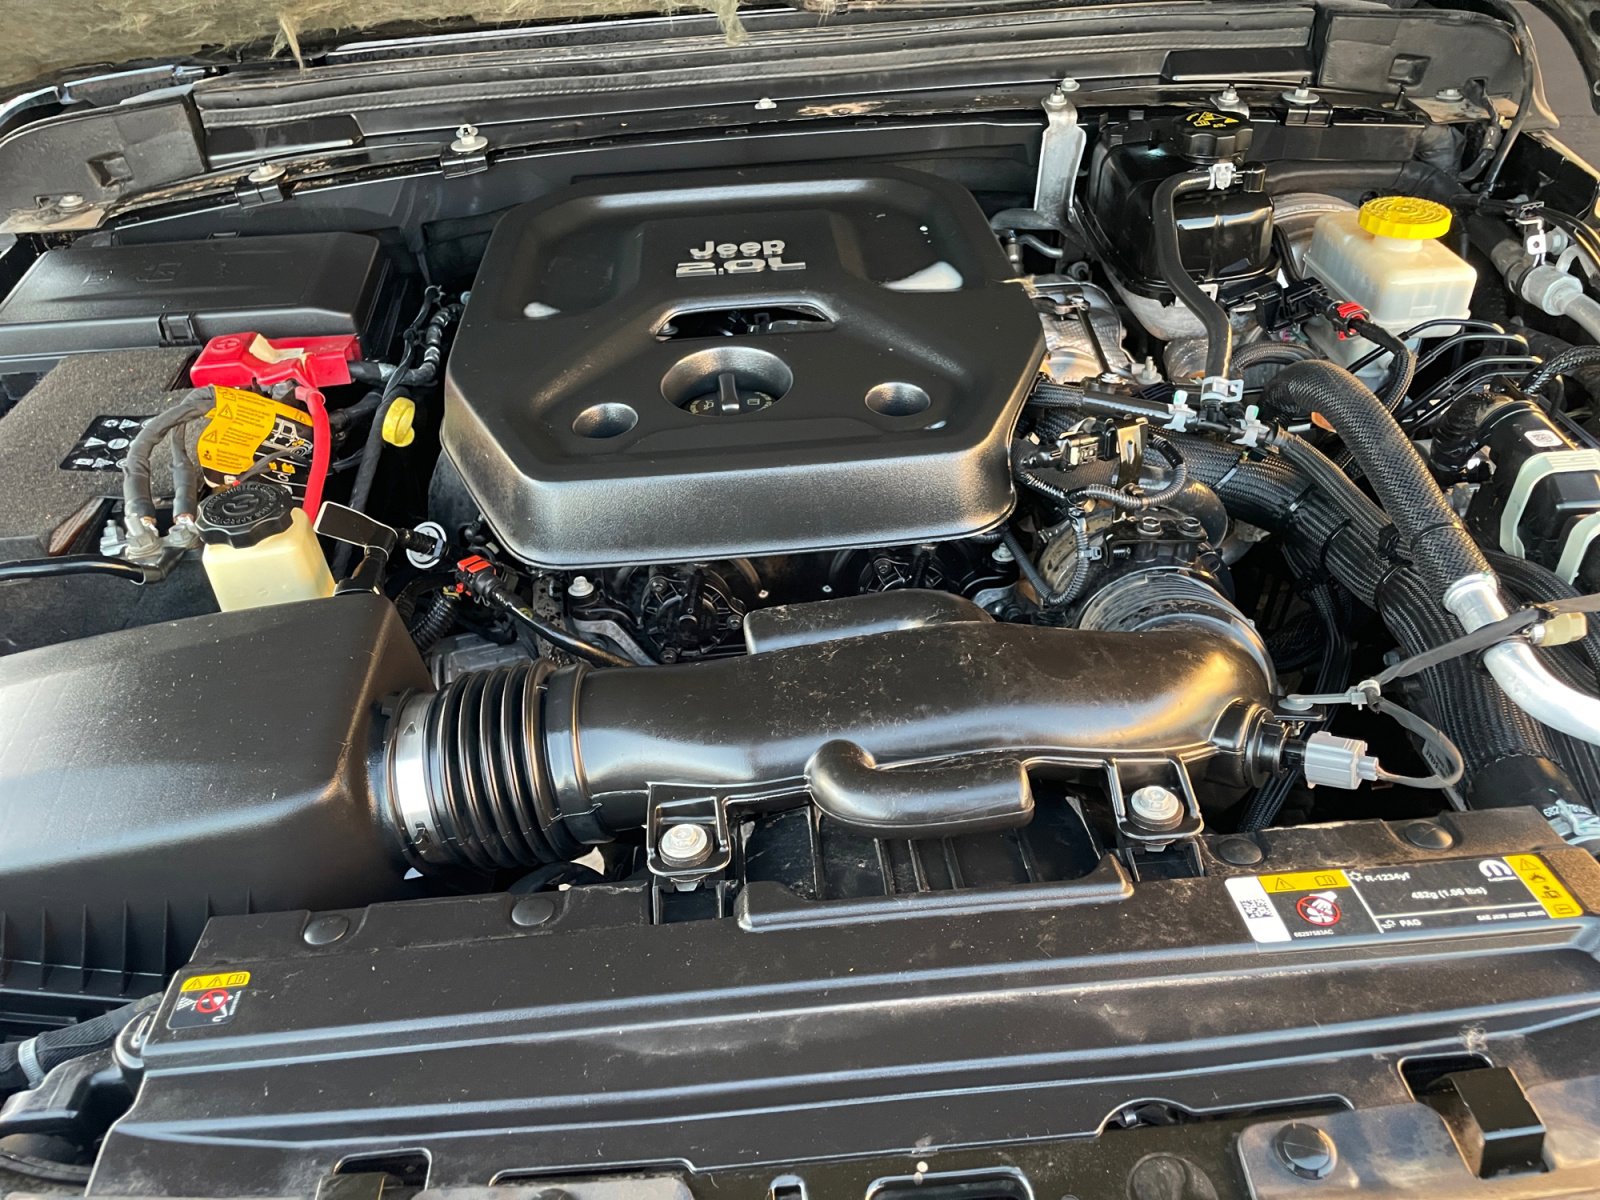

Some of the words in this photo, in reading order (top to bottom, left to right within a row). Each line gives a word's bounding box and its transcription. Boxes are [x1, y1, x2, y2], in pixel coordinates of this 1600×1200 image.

[689, 239, 786, 260] Jeep
[675, 256, 807, 278] 2.0L
[1364, 871, 1411, 882] R-1234yf
[1399, 918, 1423, 928] PAG
